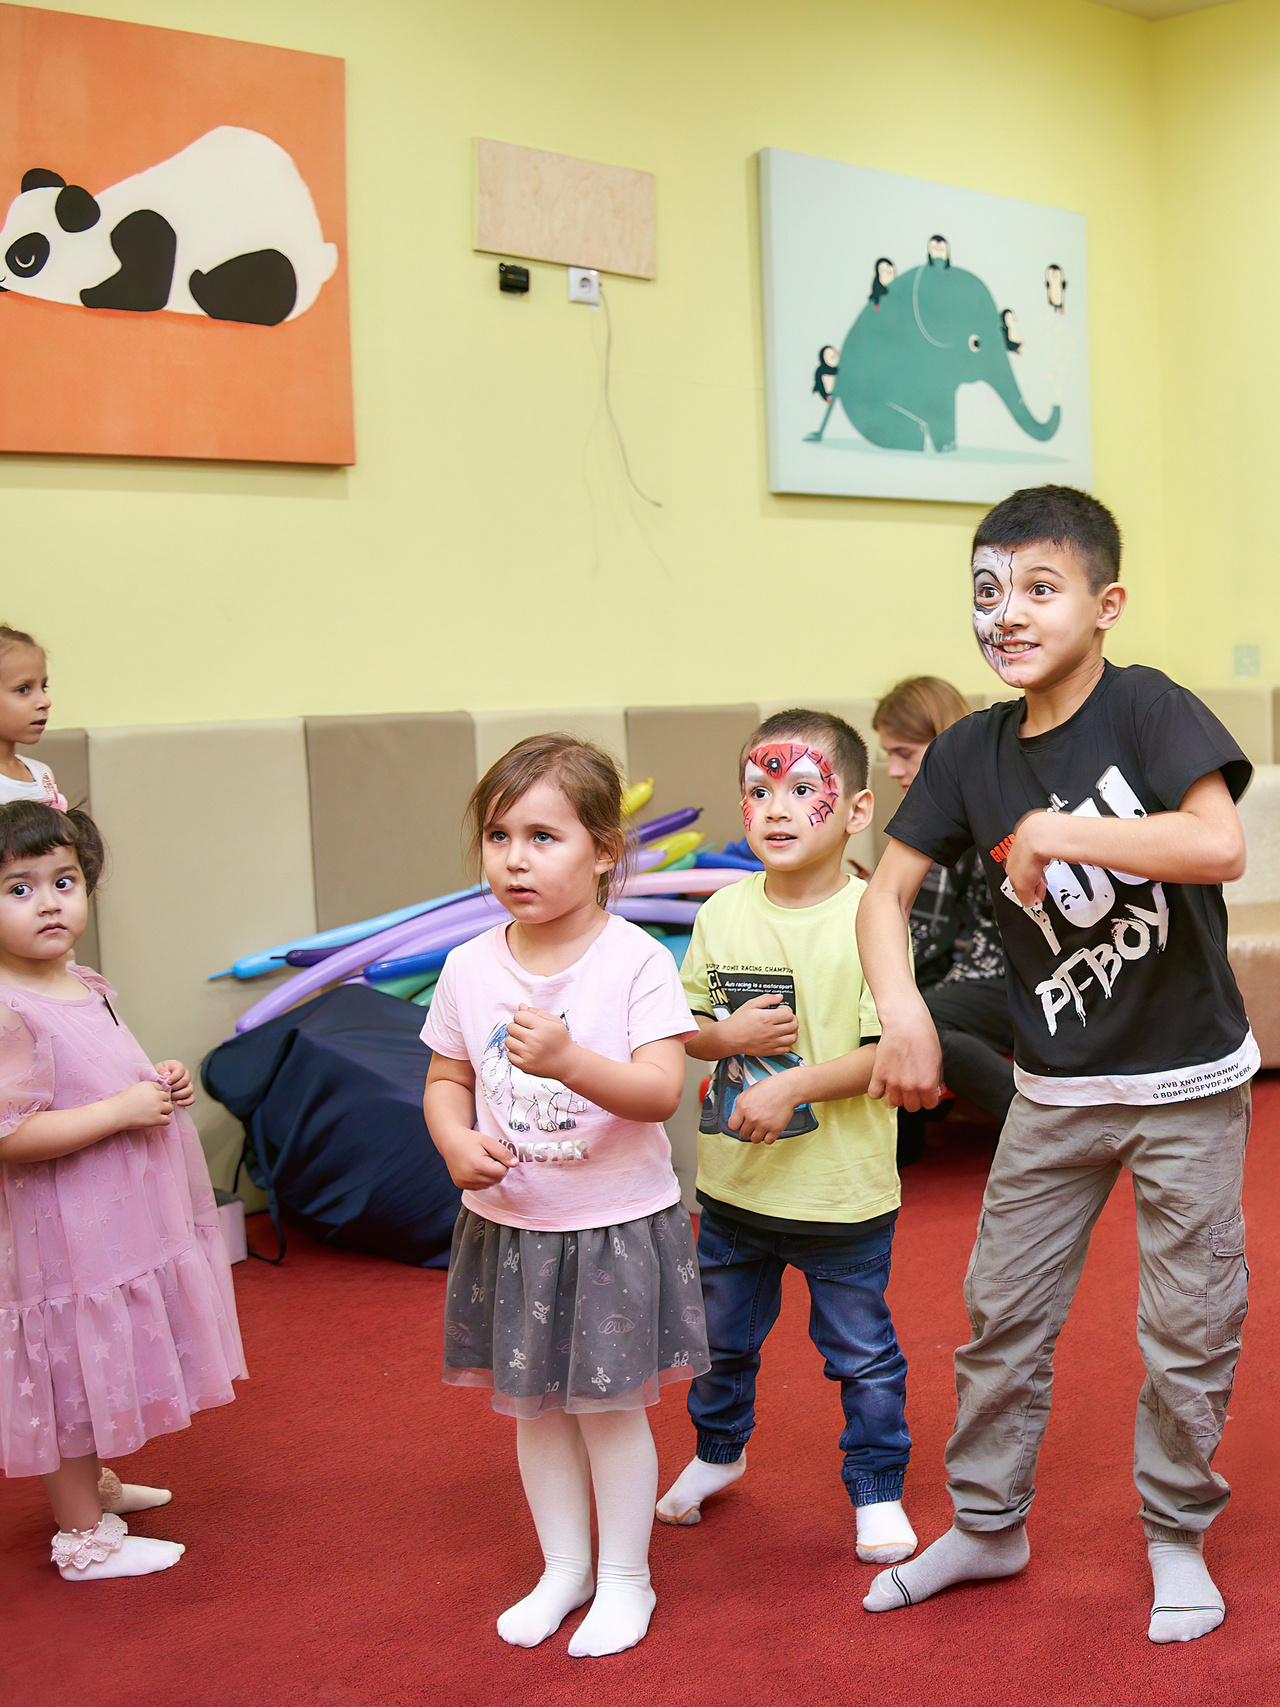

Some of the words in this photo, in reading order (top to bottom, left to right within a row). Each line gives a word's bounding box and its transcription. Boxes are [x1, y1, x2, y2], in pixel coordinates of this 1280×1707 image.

[736, 982, 752, 990] racing
[1156, 1081, 1178, 1091] JXVB
[1179, 1075, 1203, 1087] XNVB
[498, 1138, 590, 1163] ONSTER
